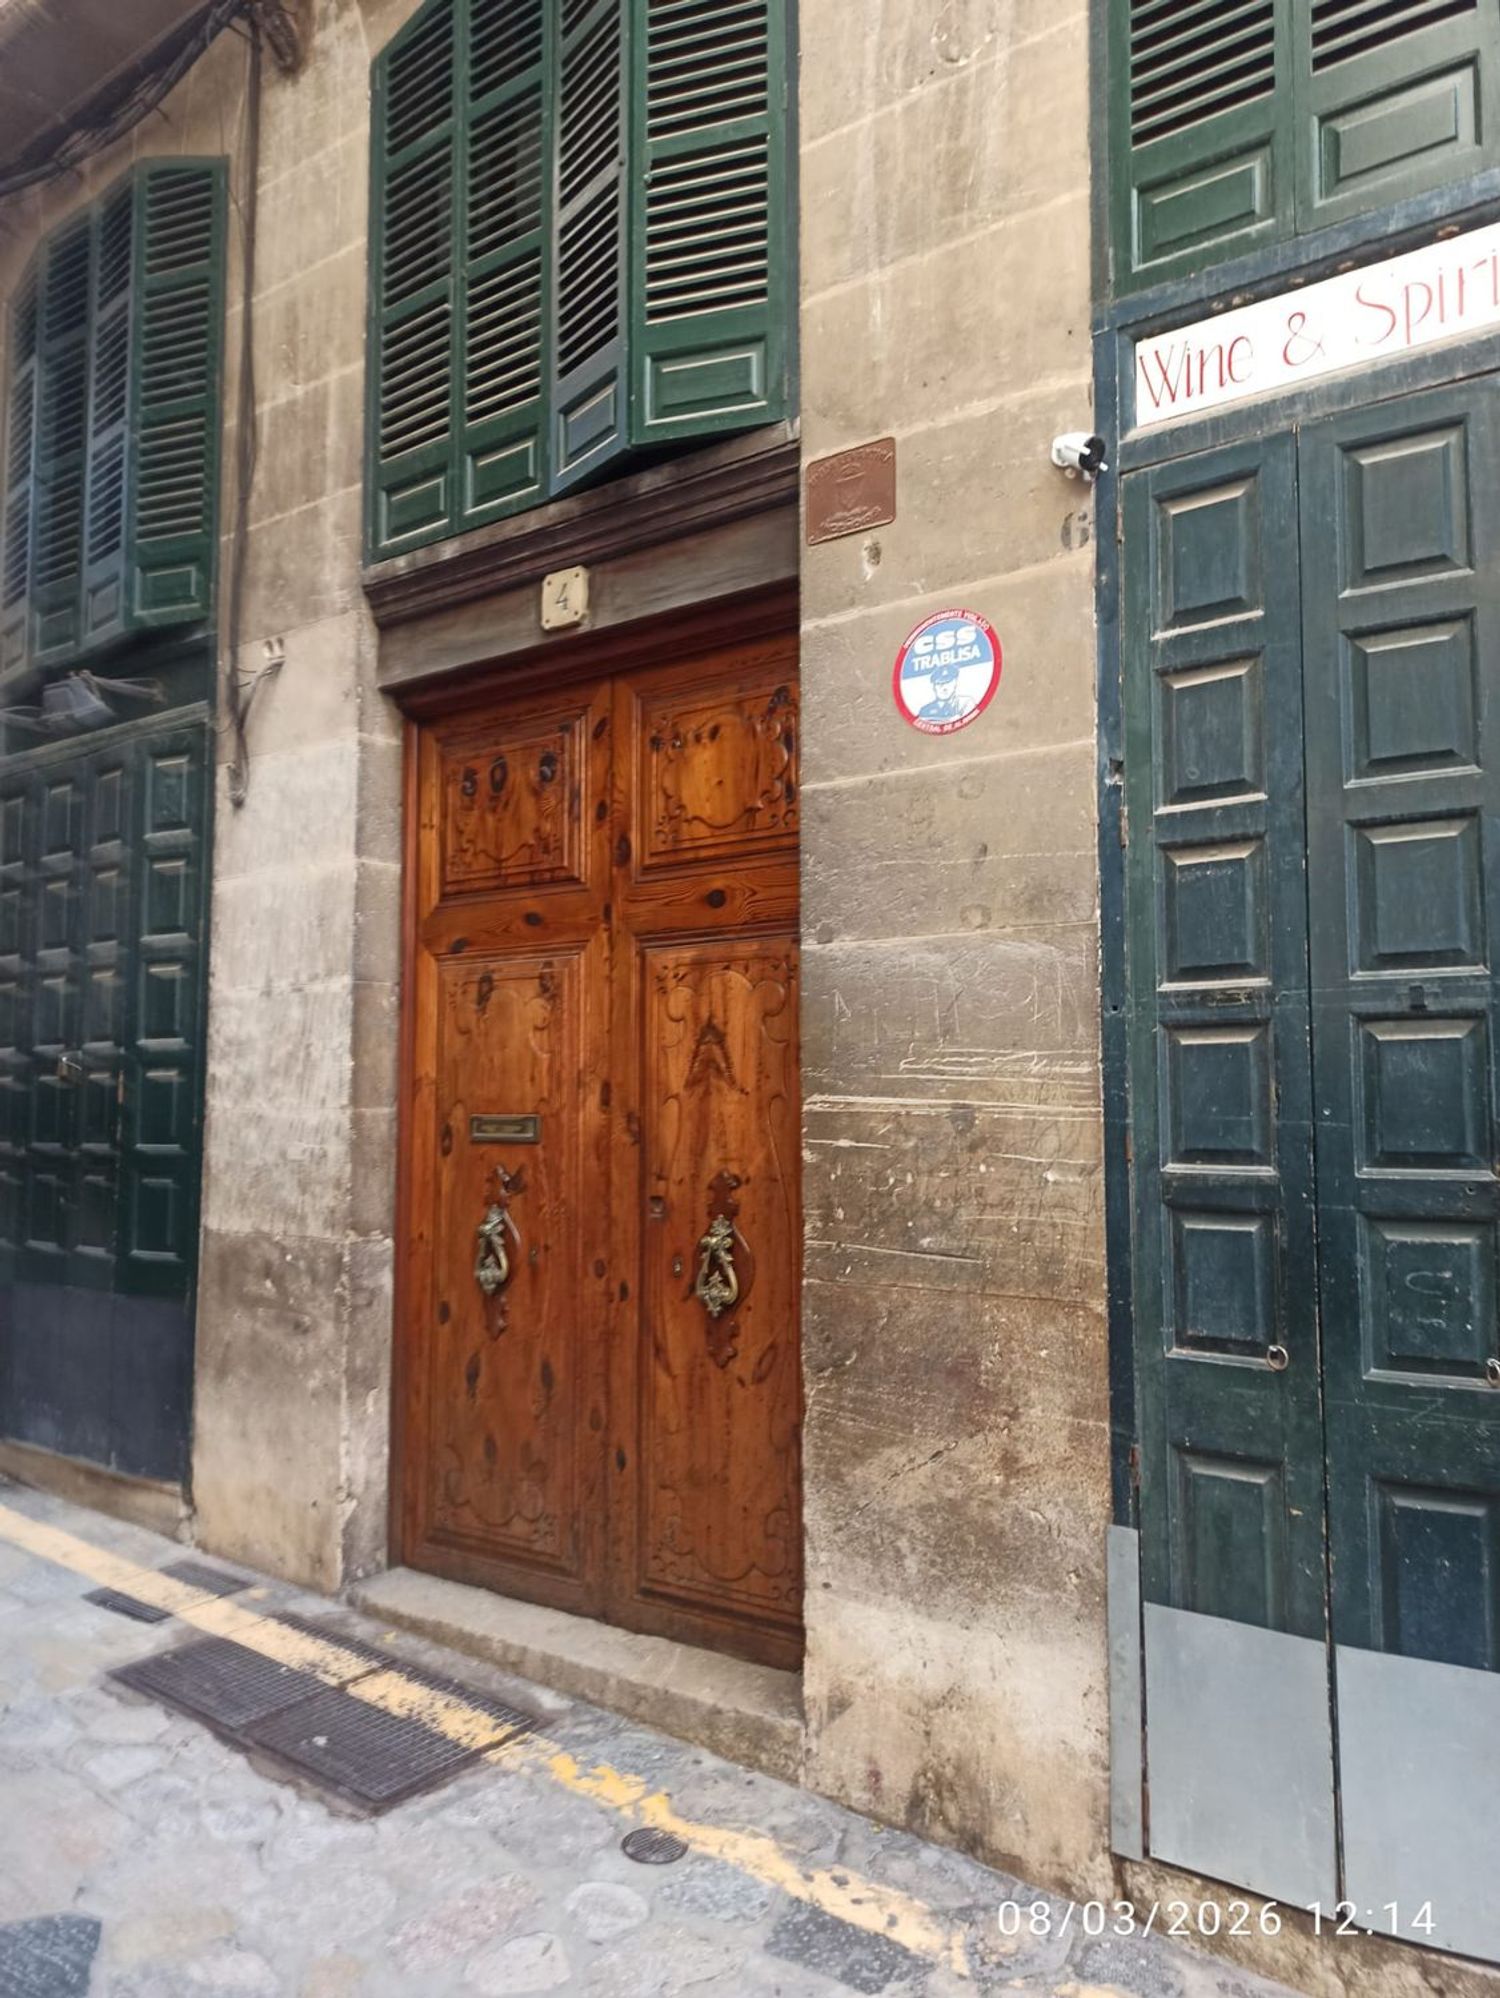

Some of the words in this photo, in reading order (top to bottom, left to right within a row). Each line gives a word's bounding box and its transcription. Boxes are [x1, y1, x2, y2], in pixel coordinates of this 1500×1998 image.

[1139, 336, 1253, 408] Wine
[1282, 312, 1327, 367] &
[1061, 511, 1090, 551] 6
[555, 582, 569, 610] 4
[913, 625, 978, 655] CSS
[911, 644, 981, 672] TRABLISA
